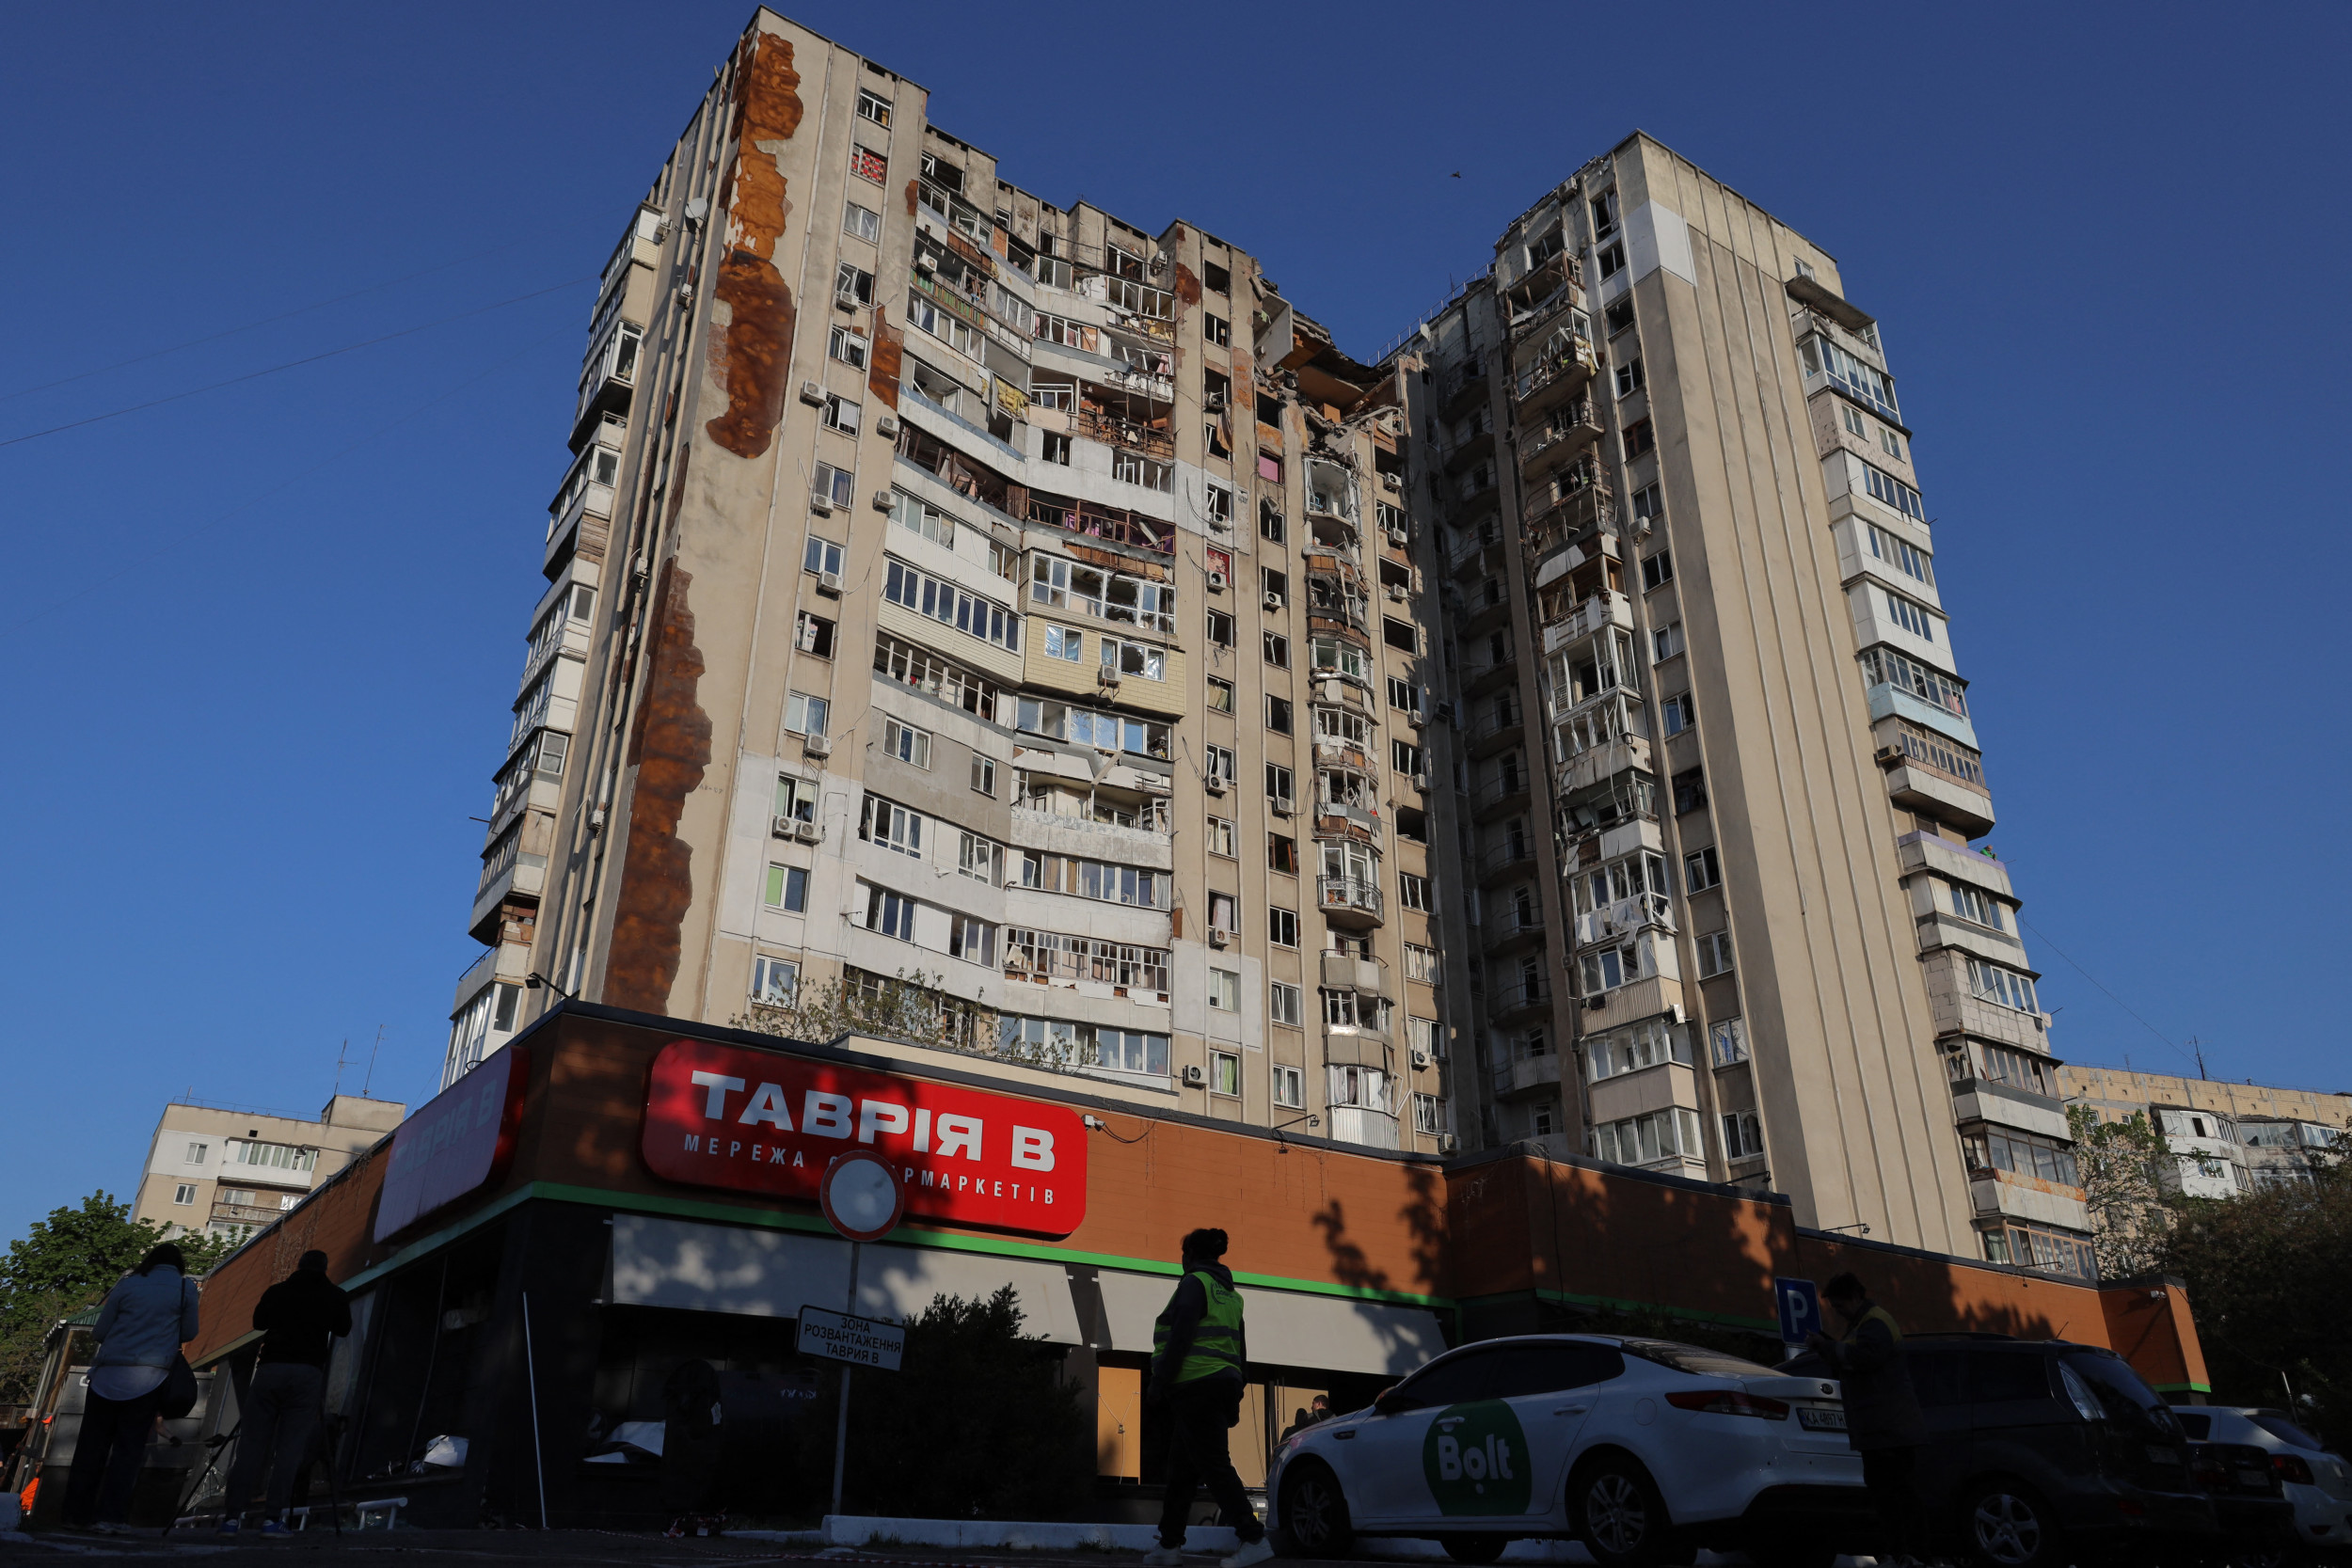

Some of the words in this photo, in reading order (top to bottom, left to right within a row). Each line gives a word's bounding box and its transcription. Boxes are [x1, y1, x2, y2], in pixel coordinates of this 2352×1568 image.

[395, 1097, 473, 1180] ТАВРІЯ
[691, 1070, 983, 1162] ТАВРІЯ
[1011, 1125, 1055, 1172] В
[684, 1133, 804, 1167] МЕРЕЖА
[829, 1155, 1054, 1205] РМАРКЕТІВ
[841, 1318, 870, 1334] ЗОНА
[1787, 1290, 1808, 1334] P
[804, 1323, 901, 1354] РОЗВАНТАЖЕННЯ
[825, 1342, 868, 1362] ТАВРИЯ
[872, 1353, 880, 1364] В
[1438, 1433, 1514, 1481] Bolt
